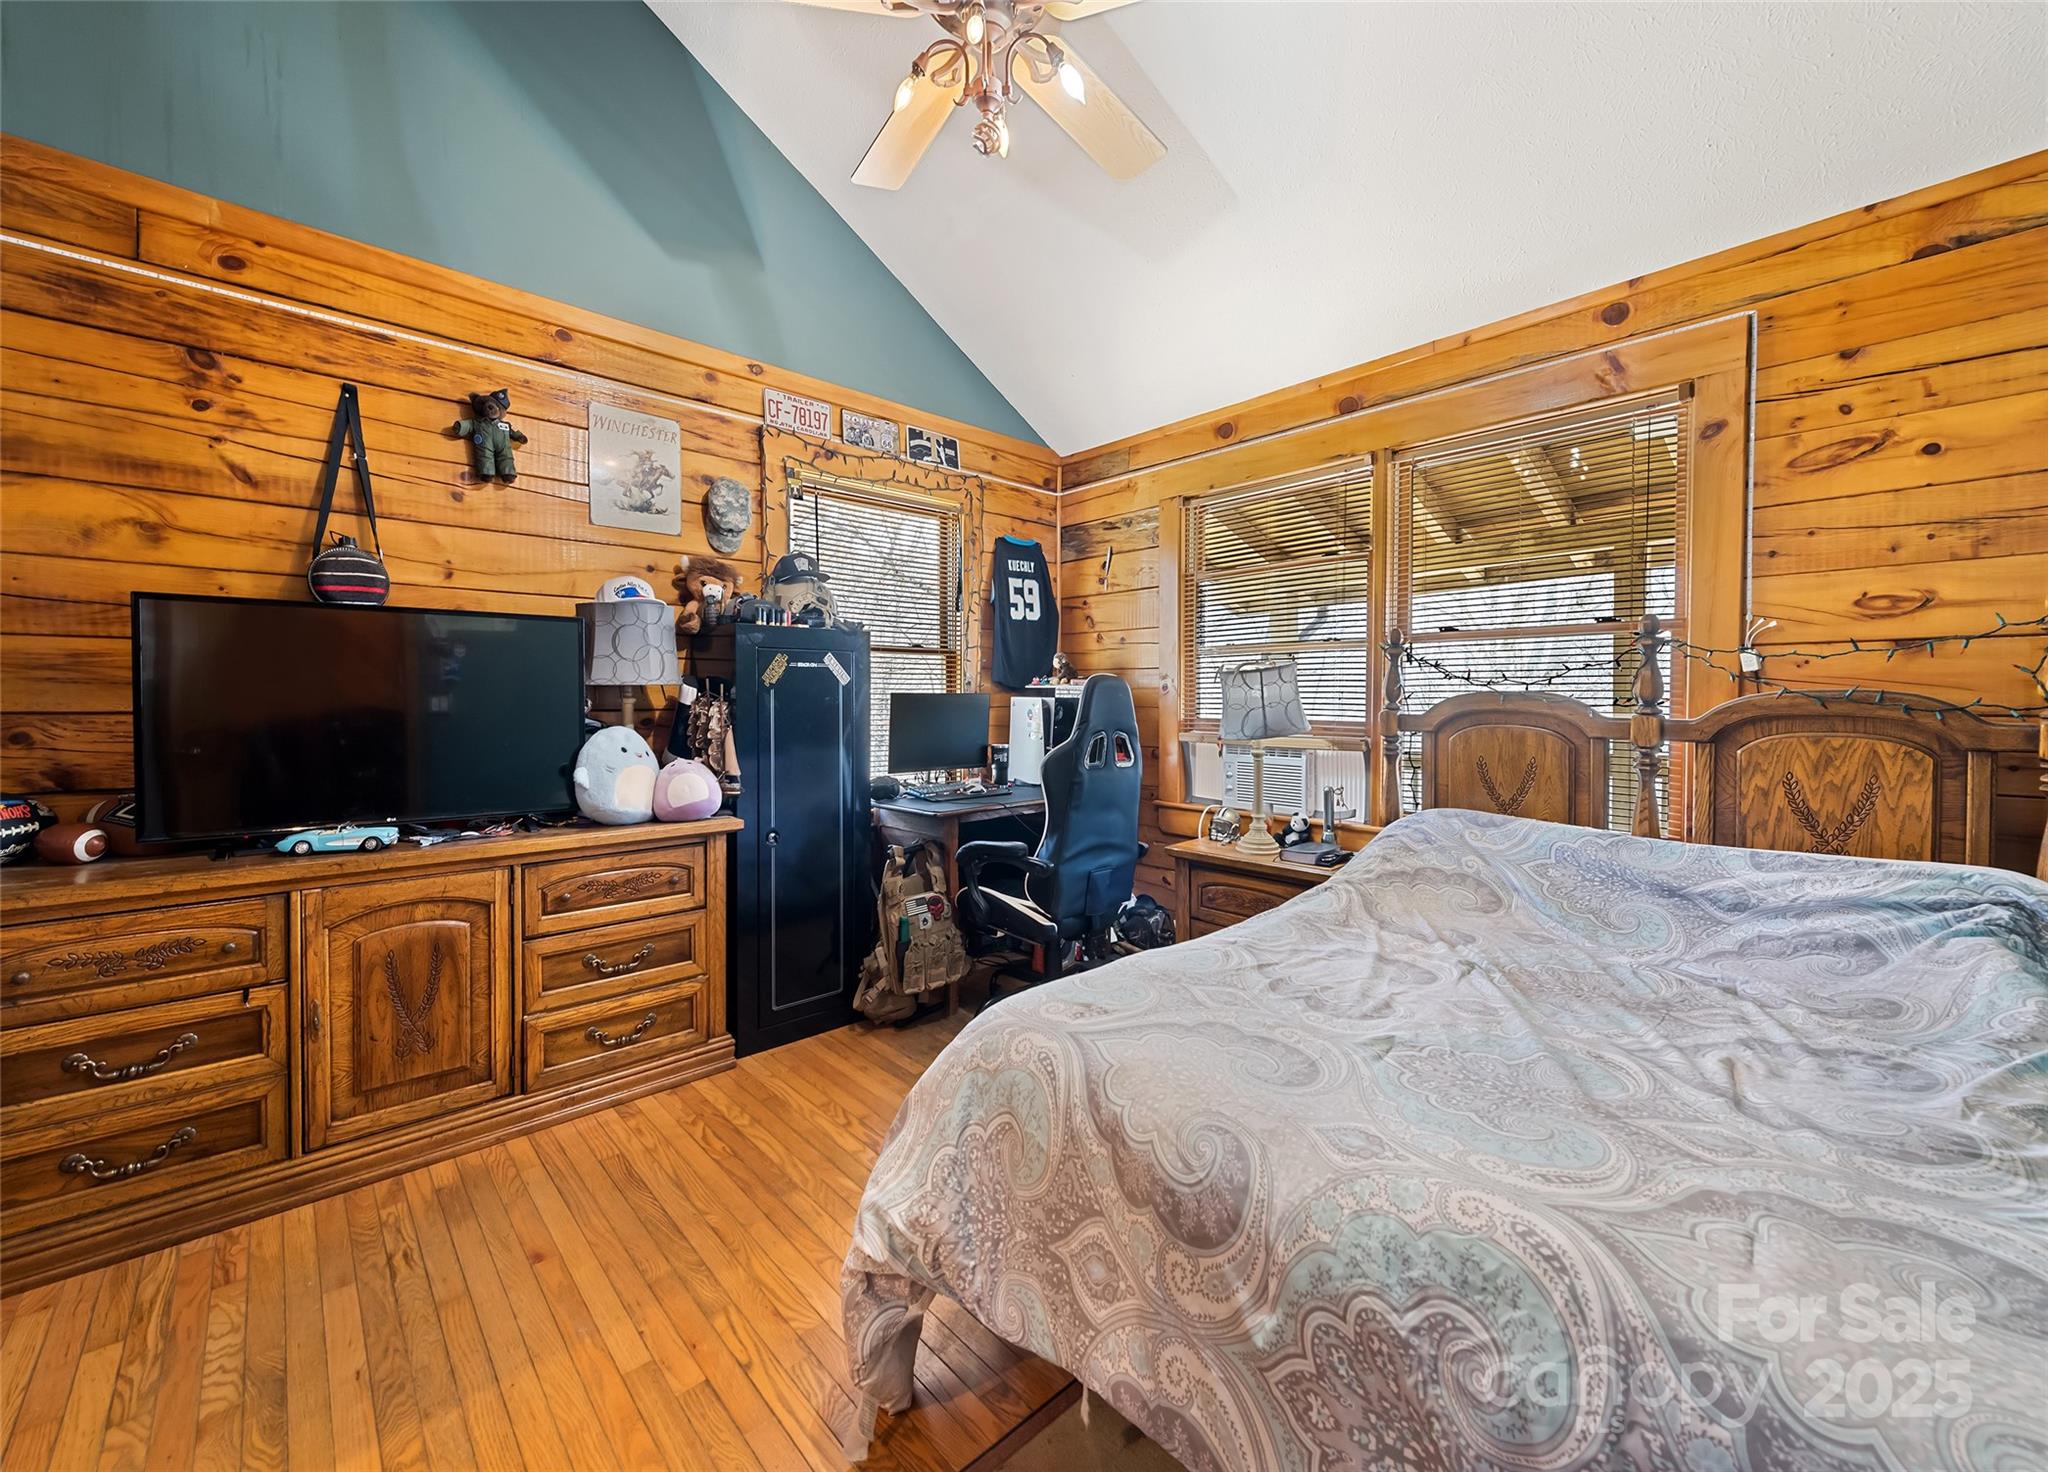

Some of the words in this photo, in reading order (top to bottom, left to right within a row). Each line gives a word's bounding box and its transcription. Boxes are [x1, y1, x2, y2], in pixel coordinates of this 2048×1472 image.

[783, 394, 814, 406] TRAILER
[768, 398, 828, 431] CF-78197
[593, 414, 677, 444] WINCHESTER
[796, 426, 828, 438] CAROLINA
[1008, 560, 1034, 573] KUECHLY
[1008, 577, 1041, 621] 59
